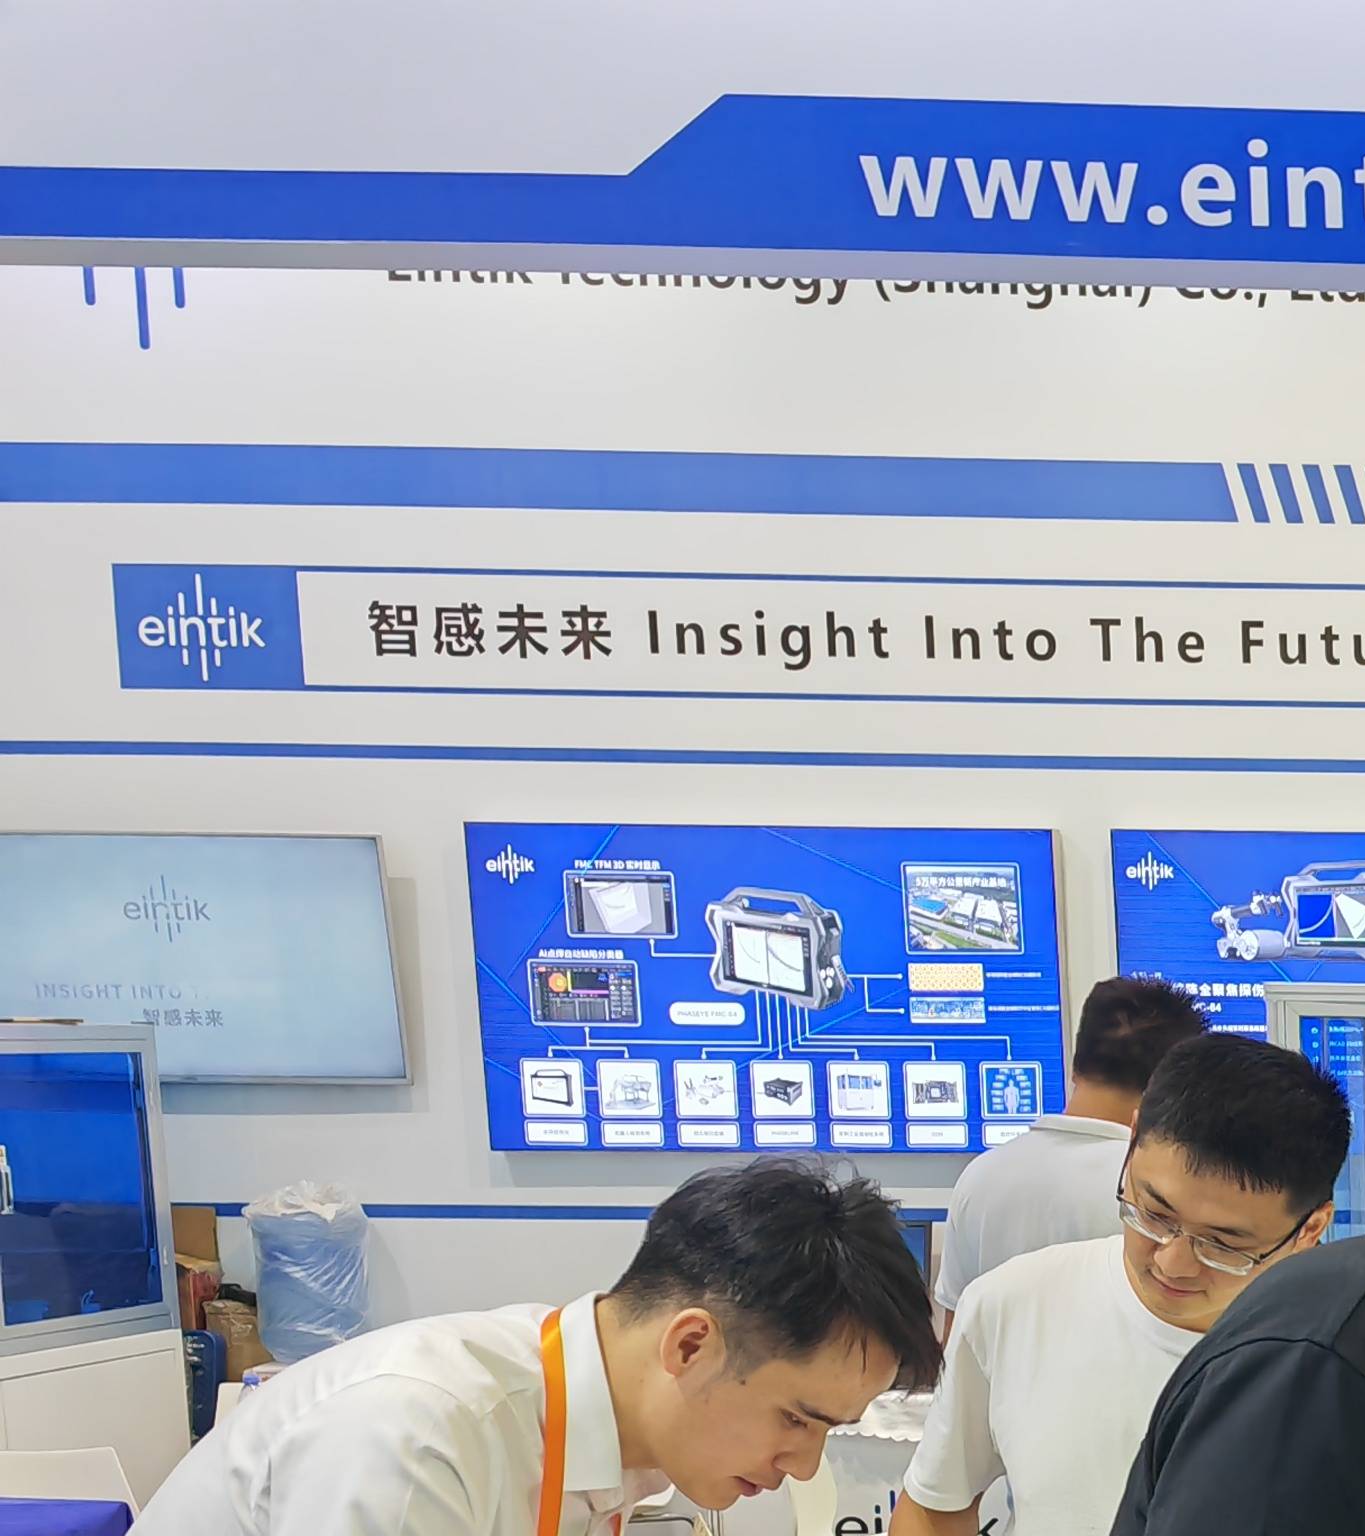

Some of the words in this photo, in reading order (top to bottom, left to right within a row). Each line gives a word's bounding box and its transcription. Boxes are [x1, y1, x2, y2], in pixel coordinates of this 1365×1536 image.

[137, 585, 266, 660] eintik
[368, 600, 613, 660] 智感未来
[647, 609, 890, 671] Insight
[924, 614, 1057, 662] Into
[1090, 616, 1205, 664] The
[34, 983, 122, 1000] INSIGHT
